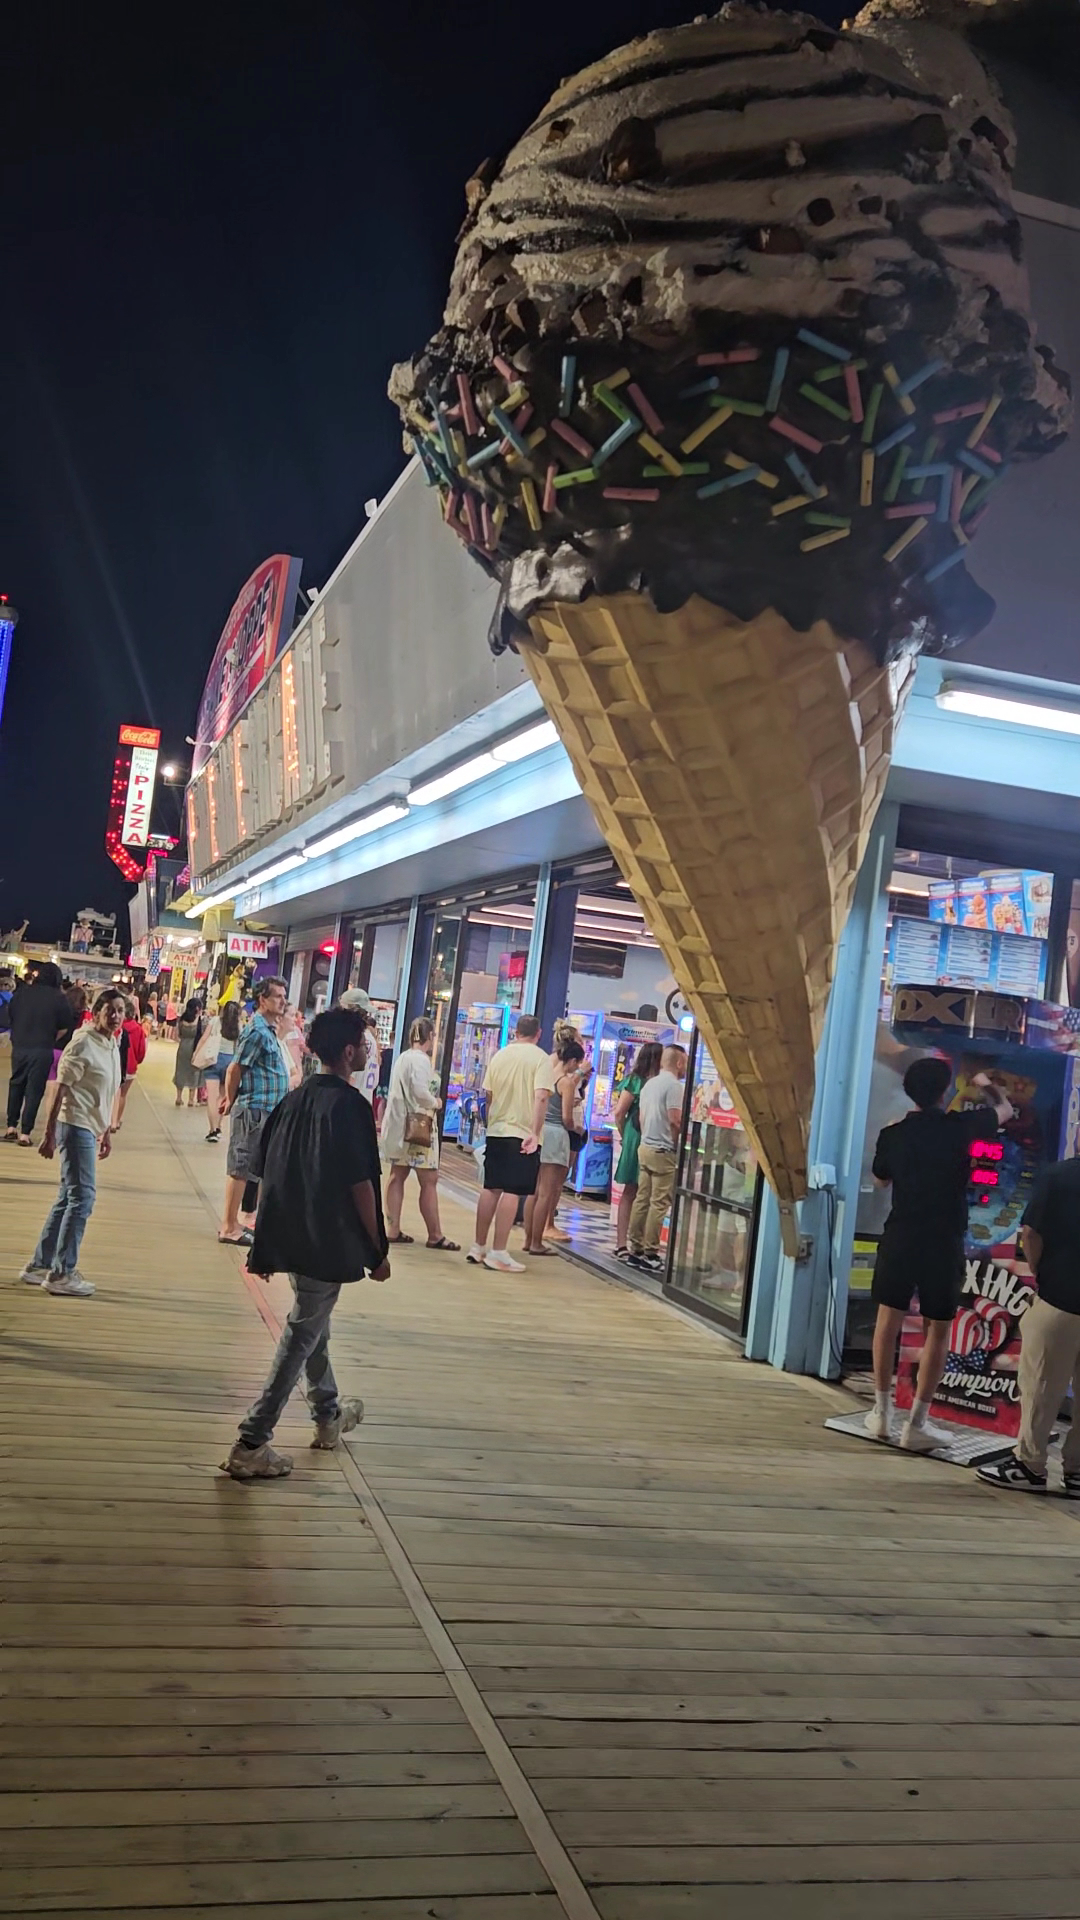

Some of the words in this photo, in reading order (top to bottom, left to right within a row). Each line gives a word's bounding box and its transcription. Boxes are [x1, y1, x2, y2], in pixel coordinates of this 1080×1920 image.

[127, 775, 150, 844] PIZZA
[230, 938, 266, 954] ATM
[174, 954, 195, 963] ATM
[961, 1259, 1035, 1317] XING
[940, 1370, 1021, 1402] ampion
[947, 1396, 976, 1409] AMERICAN
